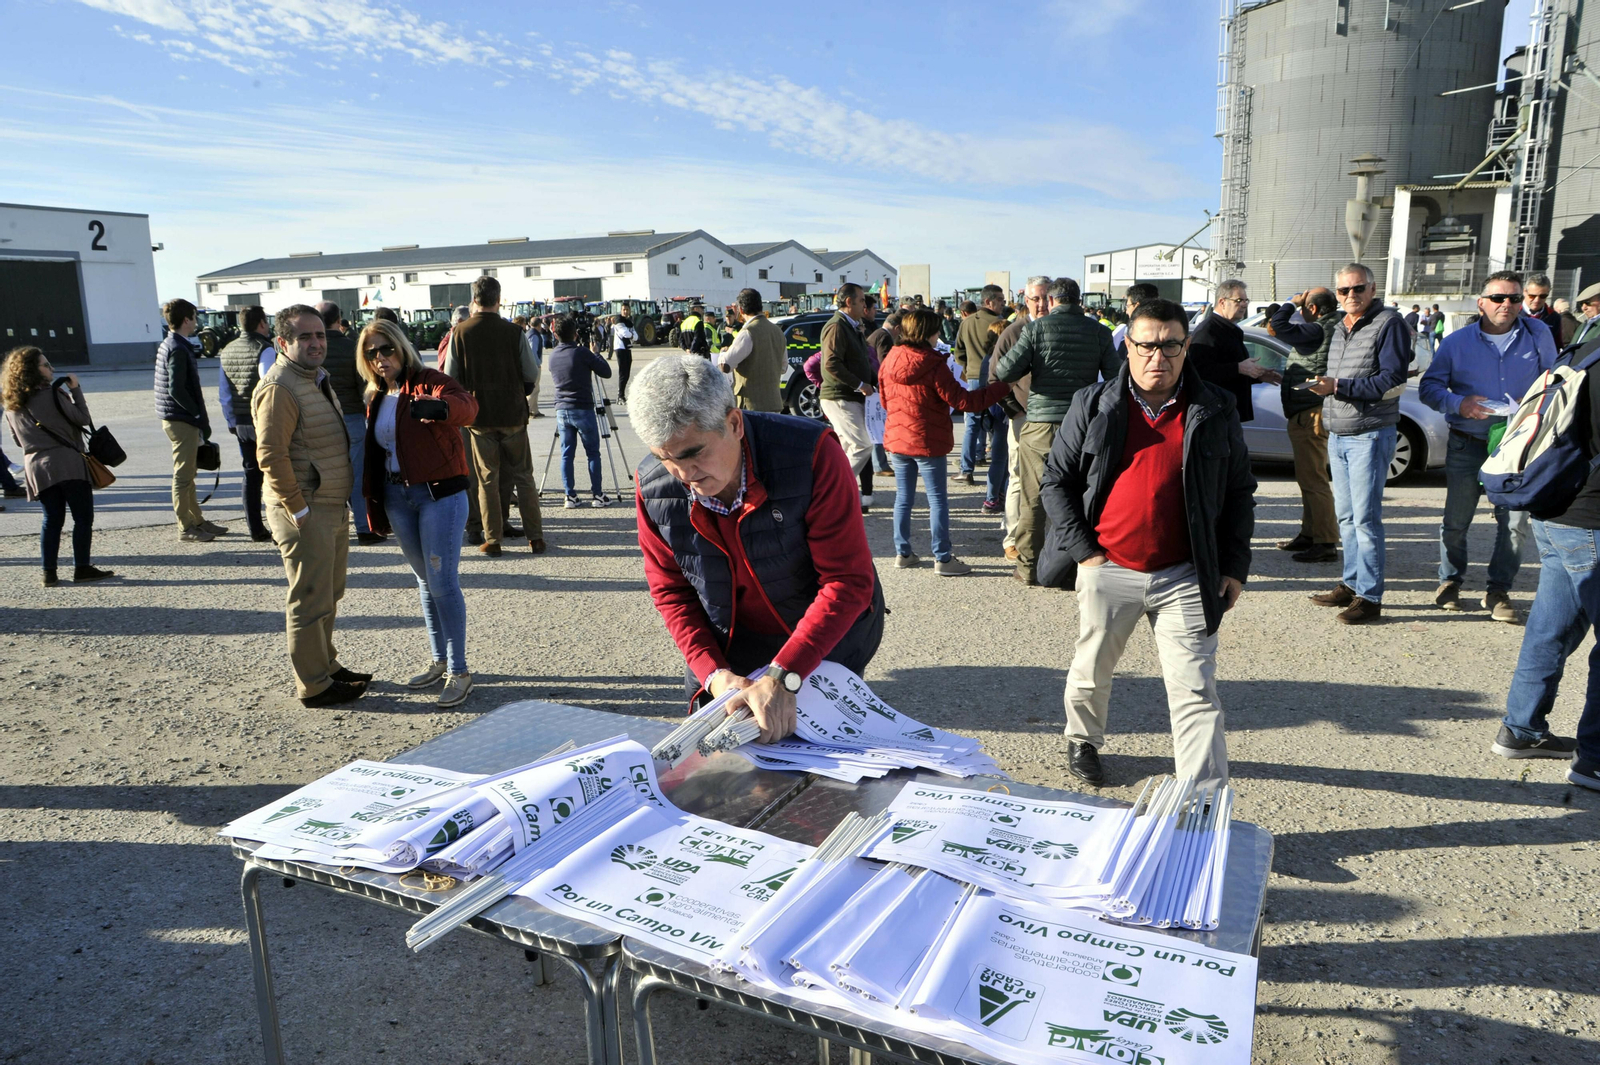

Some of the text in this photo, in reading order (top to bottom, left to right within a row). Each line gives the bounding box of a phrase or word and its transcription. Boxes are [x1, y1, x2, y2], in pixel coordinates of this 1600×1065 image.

[88, 220, 107, 251] 2
[698, 254, 704, 271] 3
[790, 263, 794, 277] 4
[1192, 254, 1199, 266] 6
[389, 276, 396, 291] 3
[864, 269, 869, 282] 5
[842, 695, 867, 718] UPA
[847, 676, 897, 719] COAG
[796, 707, 809, 718] or
[810, 720, 828, 735] un
[350, 767, 380, 777] Vivo
[382, 771, 432, 785] Campo
[509, 790, 528, 803] un
[521, 803, 541, 846] Cam
[914, 790, 1095, 822] Por un Campo Vivo
[294, 824, 362, 842] COAG
[986, 837, 1026, 854] UPA
[679, 835, 755, 863] COAG
[941, 843, 1027, 876] COAG
[663, 857, 701, 874] UPA
[740, 883, 775, 898] ASAJ
[552, 883, 726, 951] Por un Campo Viv
[668, 900, 746, 927] agro-alimentari
[675, 895, 741, 920] cooperativas
[989, 936, 1102, 972] agro-alimentarias
[998, 914, 1236, 977] Por un Campo Vivo
[1014, 952, 1100, 979] cooperativas
[980, 973, 1037, 999] ASAJA
[1104, 997, 1163, 1014] AGRICULTORES
[1103, 1010, 1158, 1034] UPA
[1048, 1033, 1166, 1065] COAG
